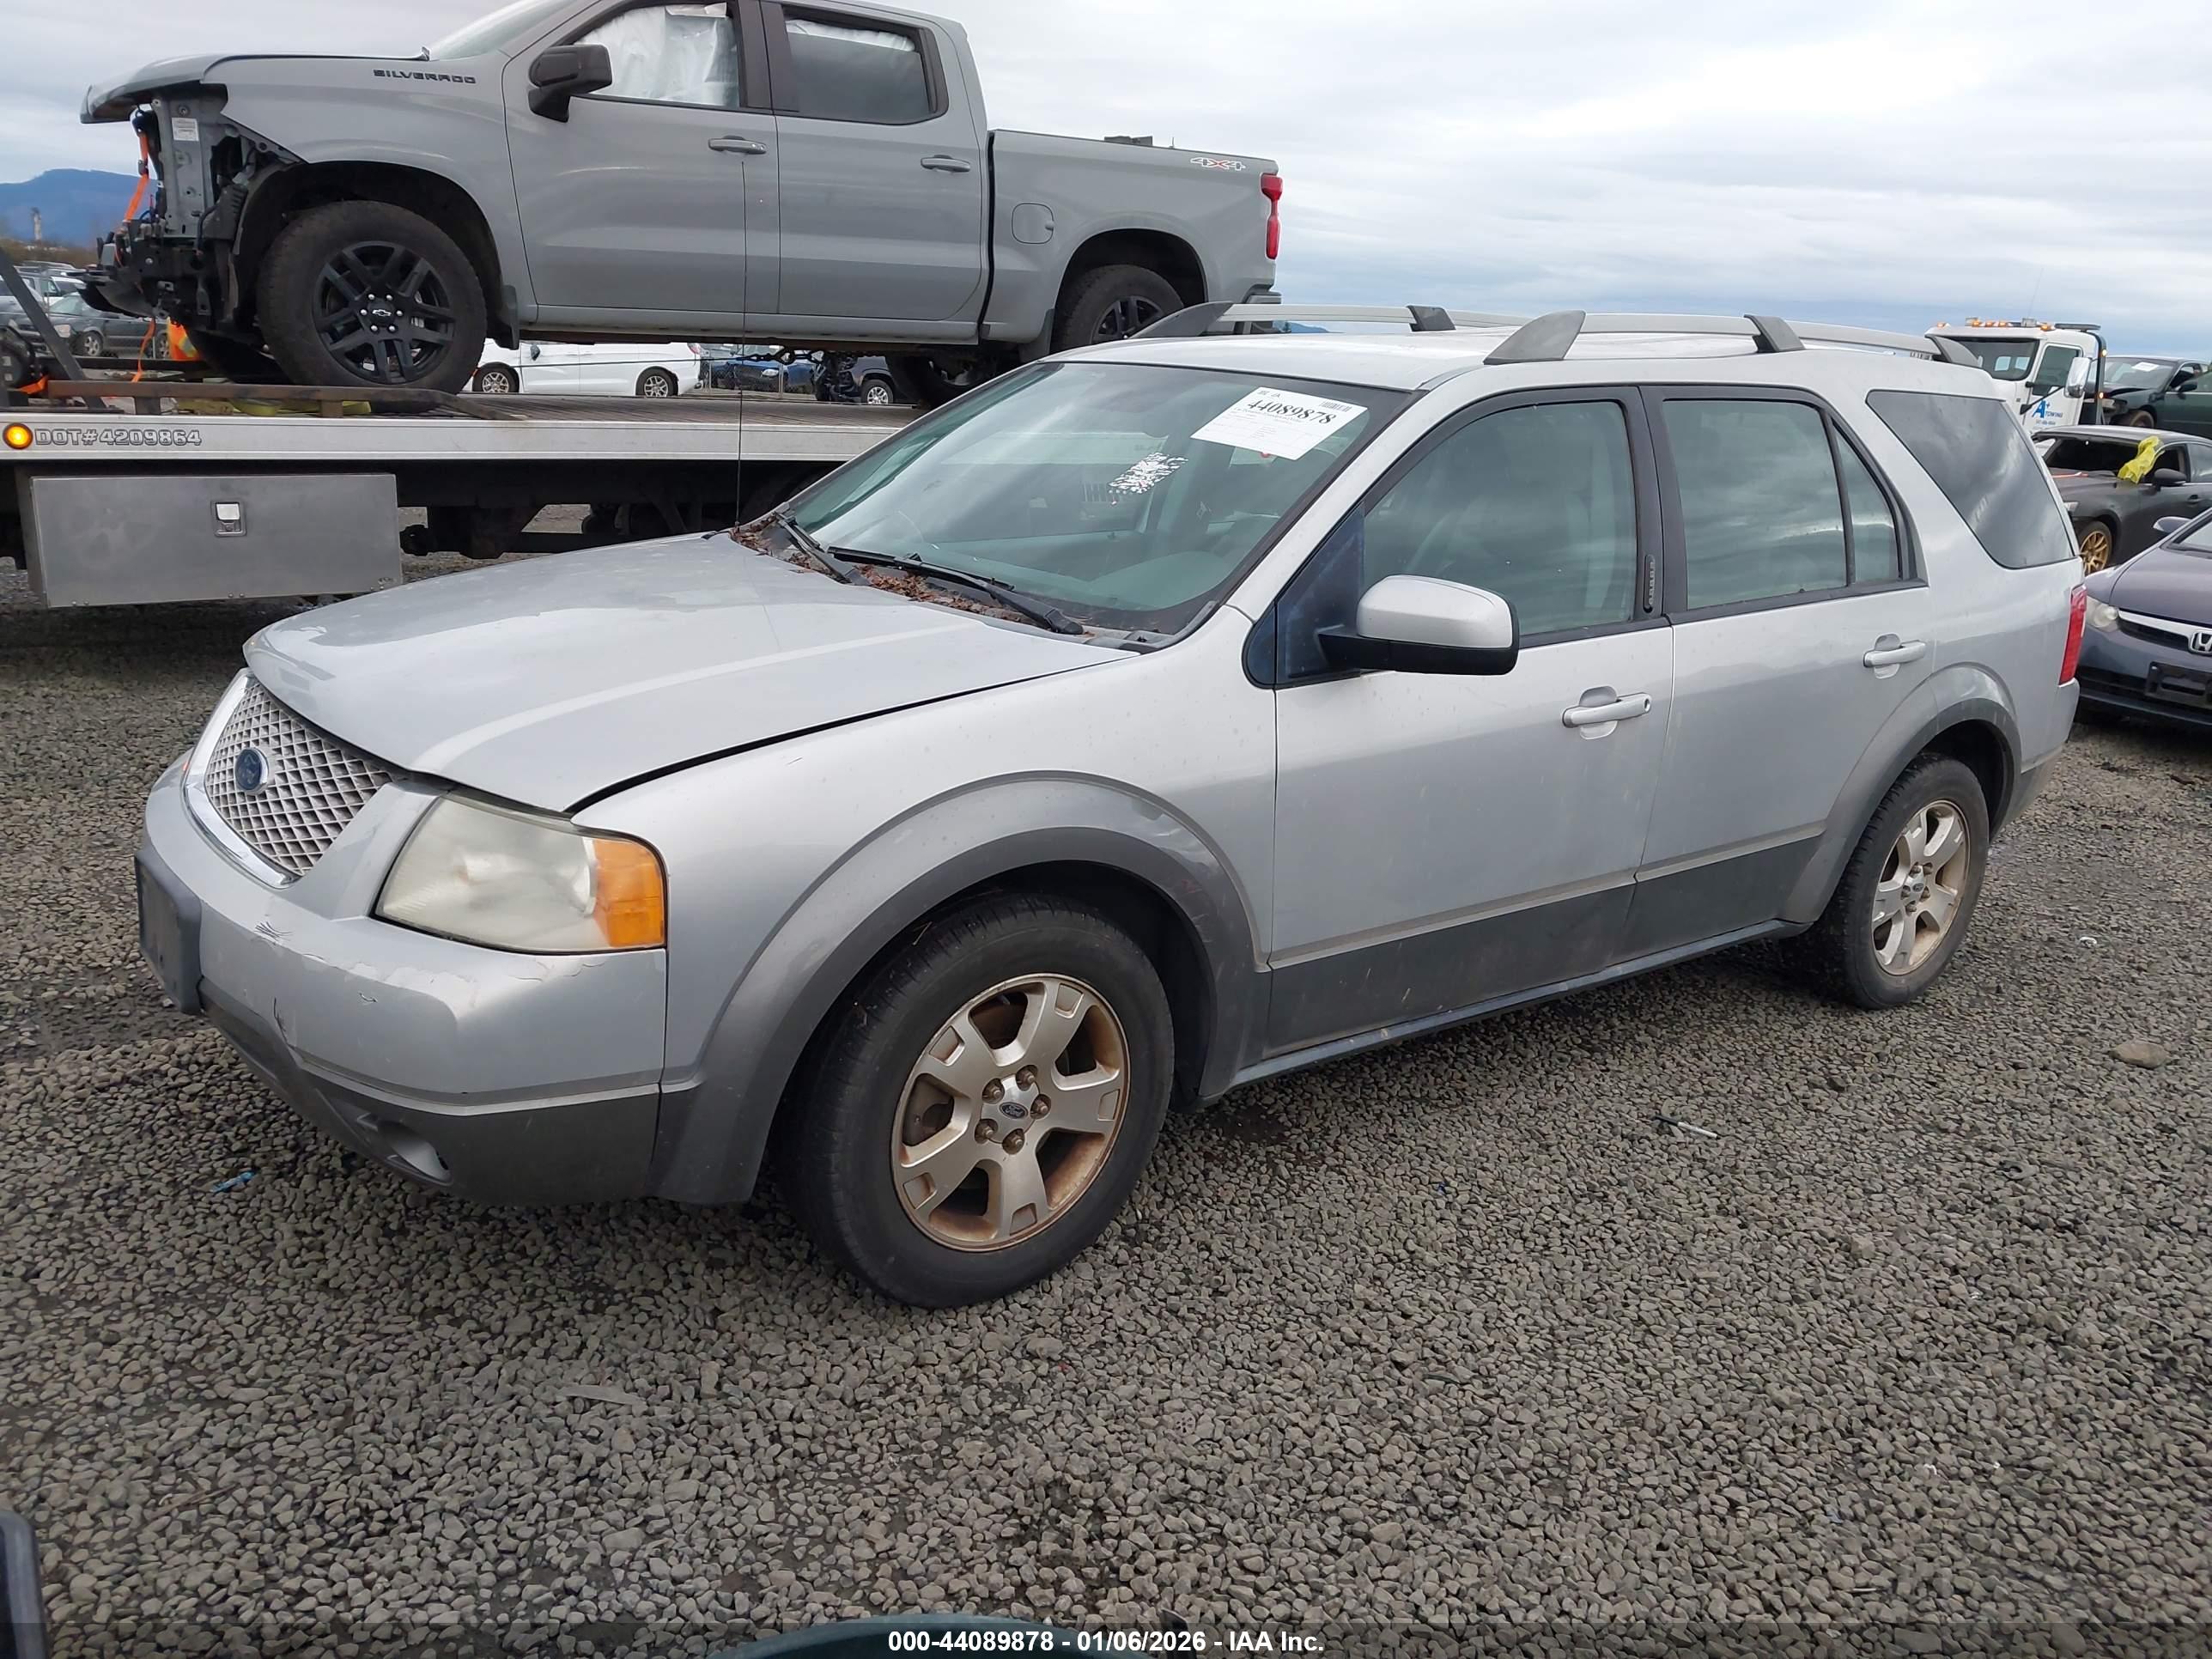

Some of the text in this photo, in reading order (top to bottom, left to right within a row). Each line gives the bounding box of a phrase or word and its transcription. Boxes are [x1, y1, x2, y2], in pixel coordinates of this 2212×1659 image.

[373, 69, 477, 84] SILVERADO
[1248, 399, 1338, 424] 44089878
[34, 428, 202, 446] DOT#4209864
